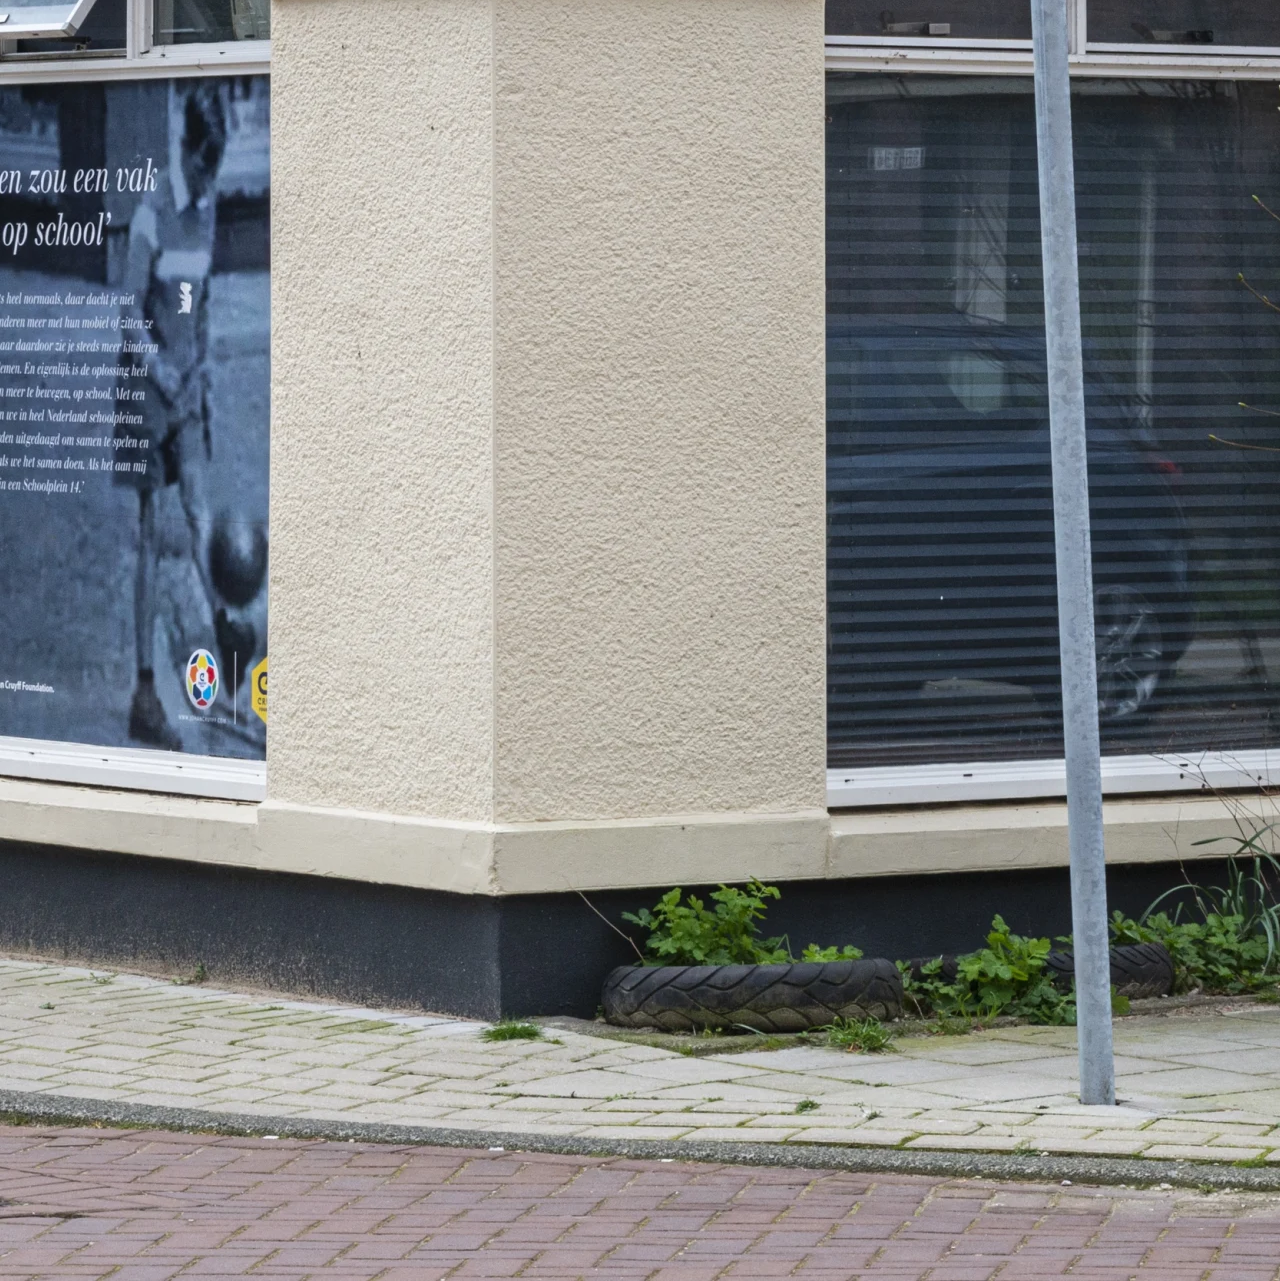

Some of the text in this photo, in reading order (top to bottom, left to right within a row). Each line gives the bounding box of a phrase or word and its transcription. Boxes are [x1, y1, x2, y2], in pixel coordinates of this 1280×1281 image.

[28, 168, 67, 194] zou
[73, 168, 109, 193] een
[116, 158, 158, 192] vak
[2, 221, 28, 255] op
[6, 292, 22, 304] heel
[65, 293, 85, 305] daar
[86, 293, 109, 305] dacht
[110, 293, 118, 309] je
[119, 294, 134, 306] niet
[27, 319, 46, 328] meer
[48, 317, 63, 328] met
[64, 316, 80, 329] hun
[82, 317, 109, 329] mobiel
[110, 317, 119, 332] of
[120, 317, 143, 329] zitten
[145, 321, 153, 329] ze
[15, 339, 53, 351] daardoor
[55, 340, 66, 352] zie
[67, 340, 75, 355] je
[76, 340, 100, 352] steeds
[101, 344, 122, 353] meer
[123, 341, 158, 353] kinderen
[24, 362, 35, 374] En
[37, 362, 70, 378] eigenlijk
[72, 363, 79, 375] is
[80, 363, 90, 375] de
[91, 364, 130, 380] oplossing
[131, 364, 147, 377] heel
[5, 679, 21, 692] Cruyff
